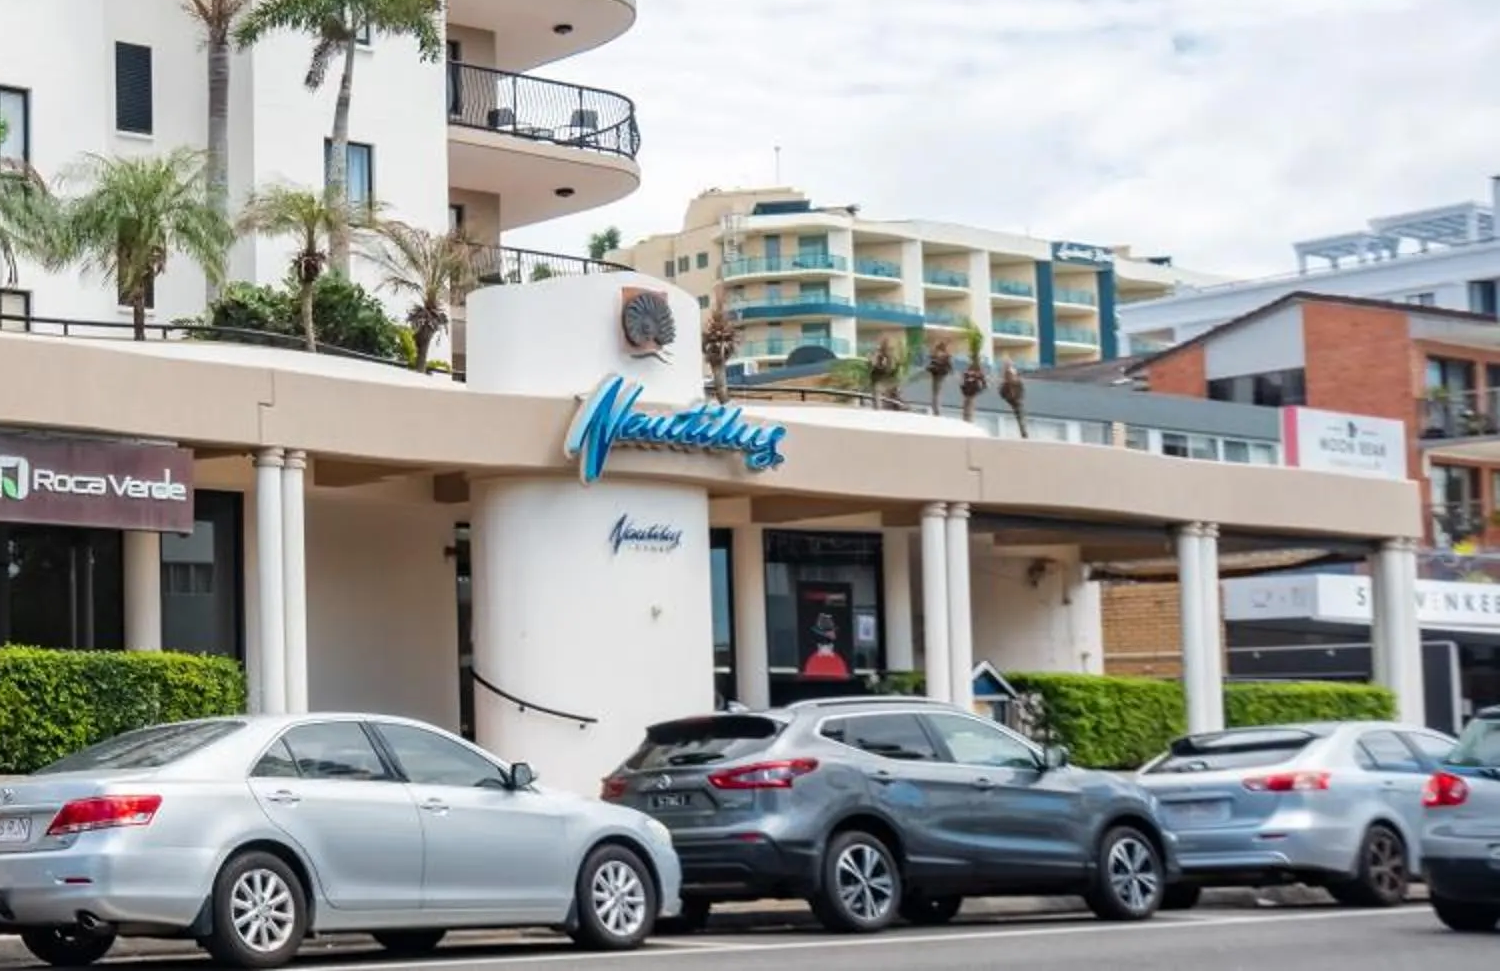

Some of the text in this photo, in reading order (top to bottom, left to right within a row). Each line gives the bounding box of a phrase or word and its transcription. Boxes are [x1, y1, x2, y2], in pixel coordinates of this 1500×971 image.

[564, 375, 788, 485] Nautilus
[33, 468, 187, 502] Roca Verde
